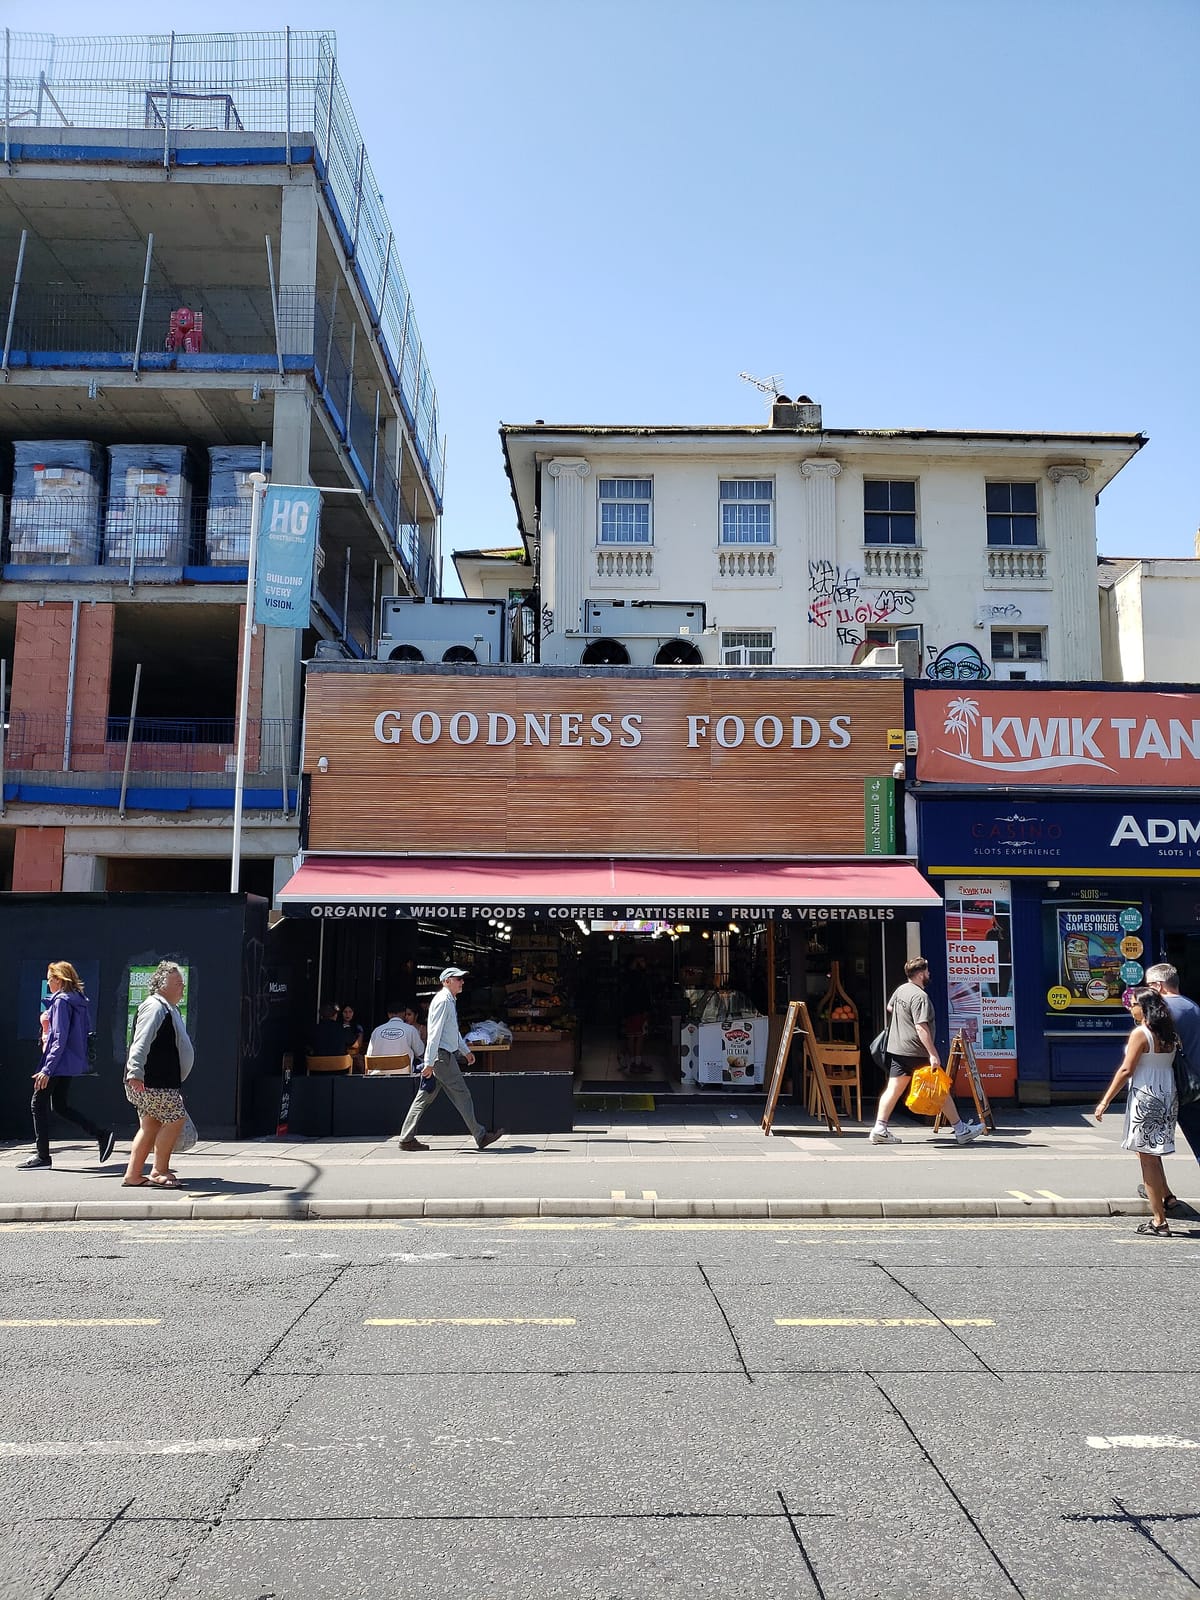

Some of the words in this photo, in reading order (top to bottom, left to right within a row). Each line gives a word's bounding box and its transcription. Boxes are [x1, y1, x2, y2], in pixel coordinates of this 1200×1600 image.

[270, 499, 310, 536] HG
[266, 572, 303, 586] BUILDING
[265, 585, 292, 598] EVERY
[265, 597, 295, 610] VISION.
[372, 709, 643, 748] GOODNESS
[685, 714, 853, 750] FOODS
[981, 716, 1105, 759] KWIK
[1110, 717, 1200, 760] TAN
[871, 804, 881, 835] Natural
[971, 823, 1062, 840] CASINO
[1110, 815, 1200, 847] ADM
[871, 836, 883, 853] Just
[974, 848, 1002, 856] SLOTS
[1005, 848, 1061, 856] EXPERIENCE
[1158, 849, 1184, 857] SLOTS
[1080, 889, 1100, 899] SLOTS
[310, 905, 388, 918] ORGANIC
[409, 906, 467, 918] WHOLE
[471, 906, 526, 919] FOODS
[548, 907, 604, 919] COFFEE
[625, 907, 710, 919] PATTISERIE
[731, 908, 775, 919] FRUIT
[782, 908, 792, 919] &
[797, 908, 895, 920] VEGETABLES
[1067, 914, 1083, 923] TOP
[1084, 914, 1117, 923] BOOKIES
[1066, 923, 1093, 932] GAMES
[1095, 923, 1119, 932] INSIDE
[948, 943, 976, 953] Free
[948, 953, 995, 964] sunbed
[948, 964, 996, 975] session
[982, 1005, 1012, 1013] premium
